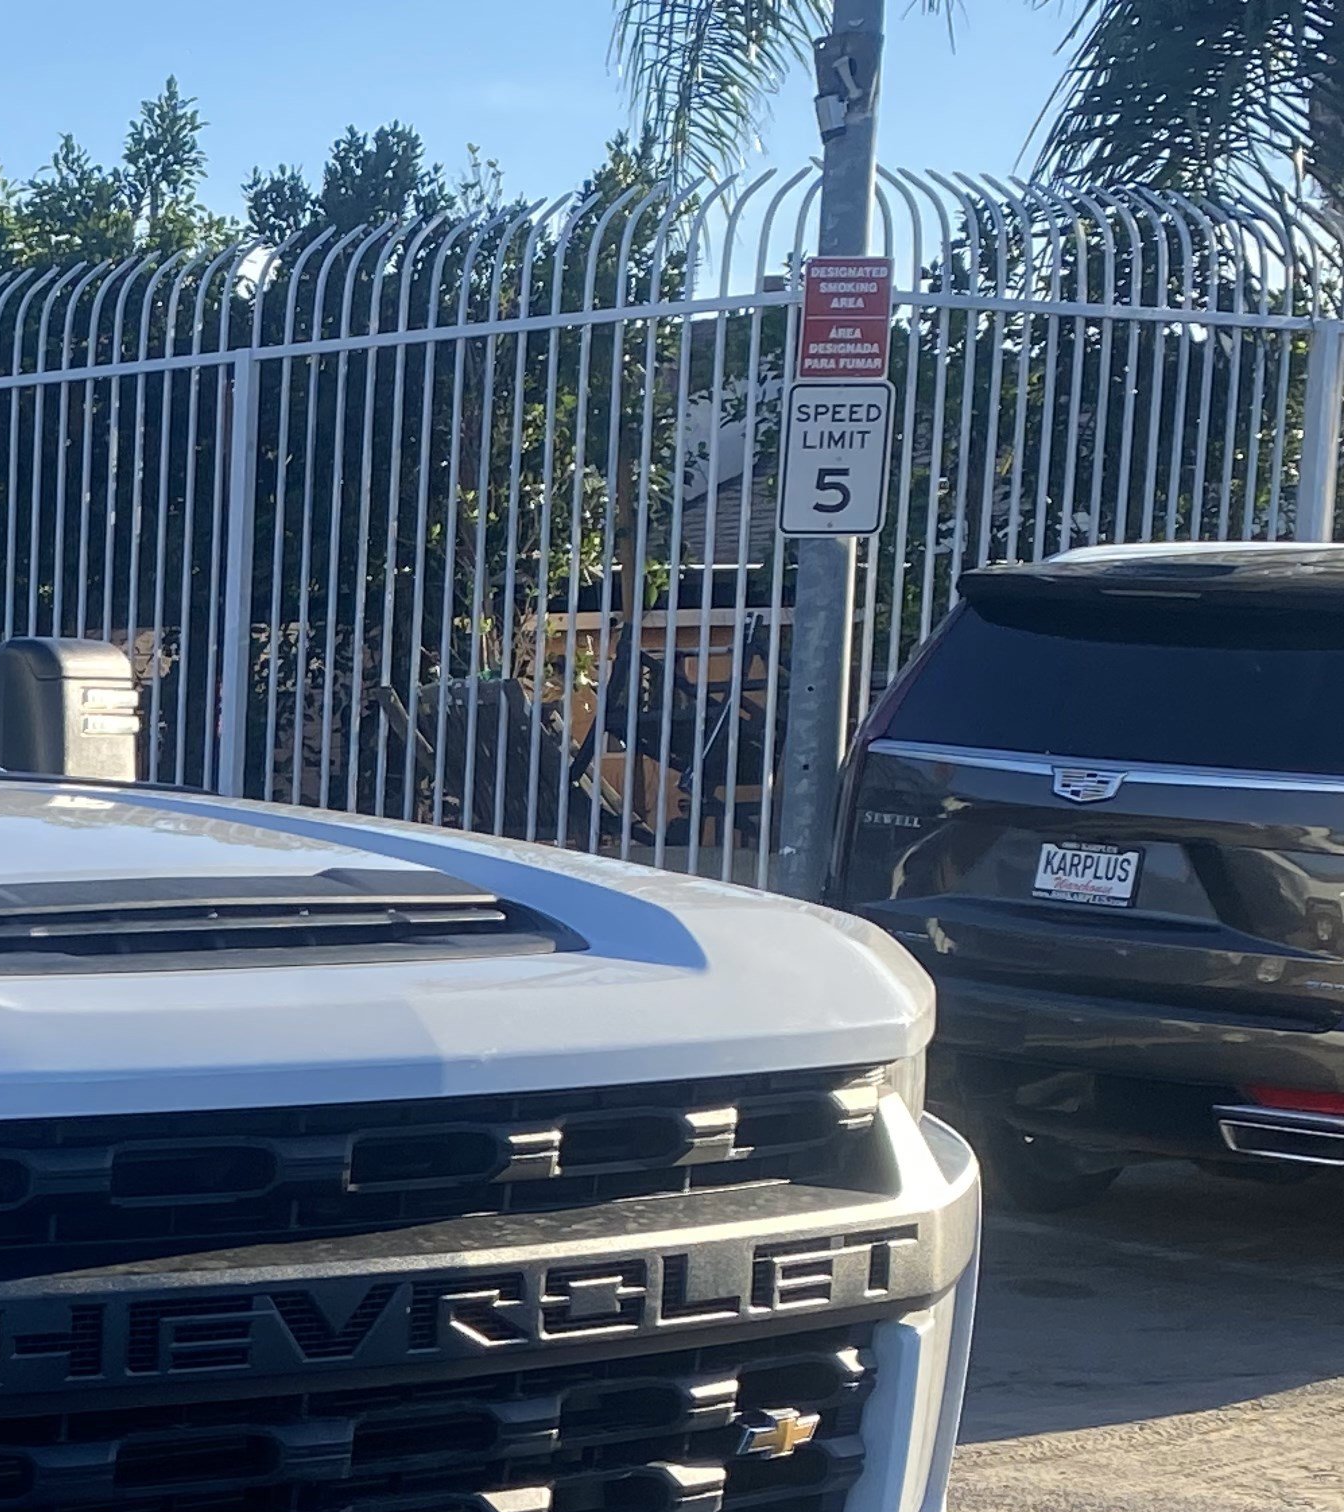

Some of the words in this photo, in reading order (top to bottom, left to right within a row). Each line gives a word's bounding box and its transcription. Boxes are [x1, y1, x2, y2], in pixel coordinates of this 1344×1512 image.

[810, 265, 888, 279] DESIGNATED
[819, 281, 878, 294] SMOKING
[829, 296, 865, 309] AREA
[828, 325, 863, 340] ÁREA
[808, 341, 880, 355] DESIGNADA
[804, 357, 836, 370] PARA
[838, 357, 883, 370] FUMAR
[795, 403, 882, 424] SPEED
[801, 430, 872, 450] LIMIT
[812, 467, 852, 514] 5
[1043, 849, 1132, 883] KARPLUS
